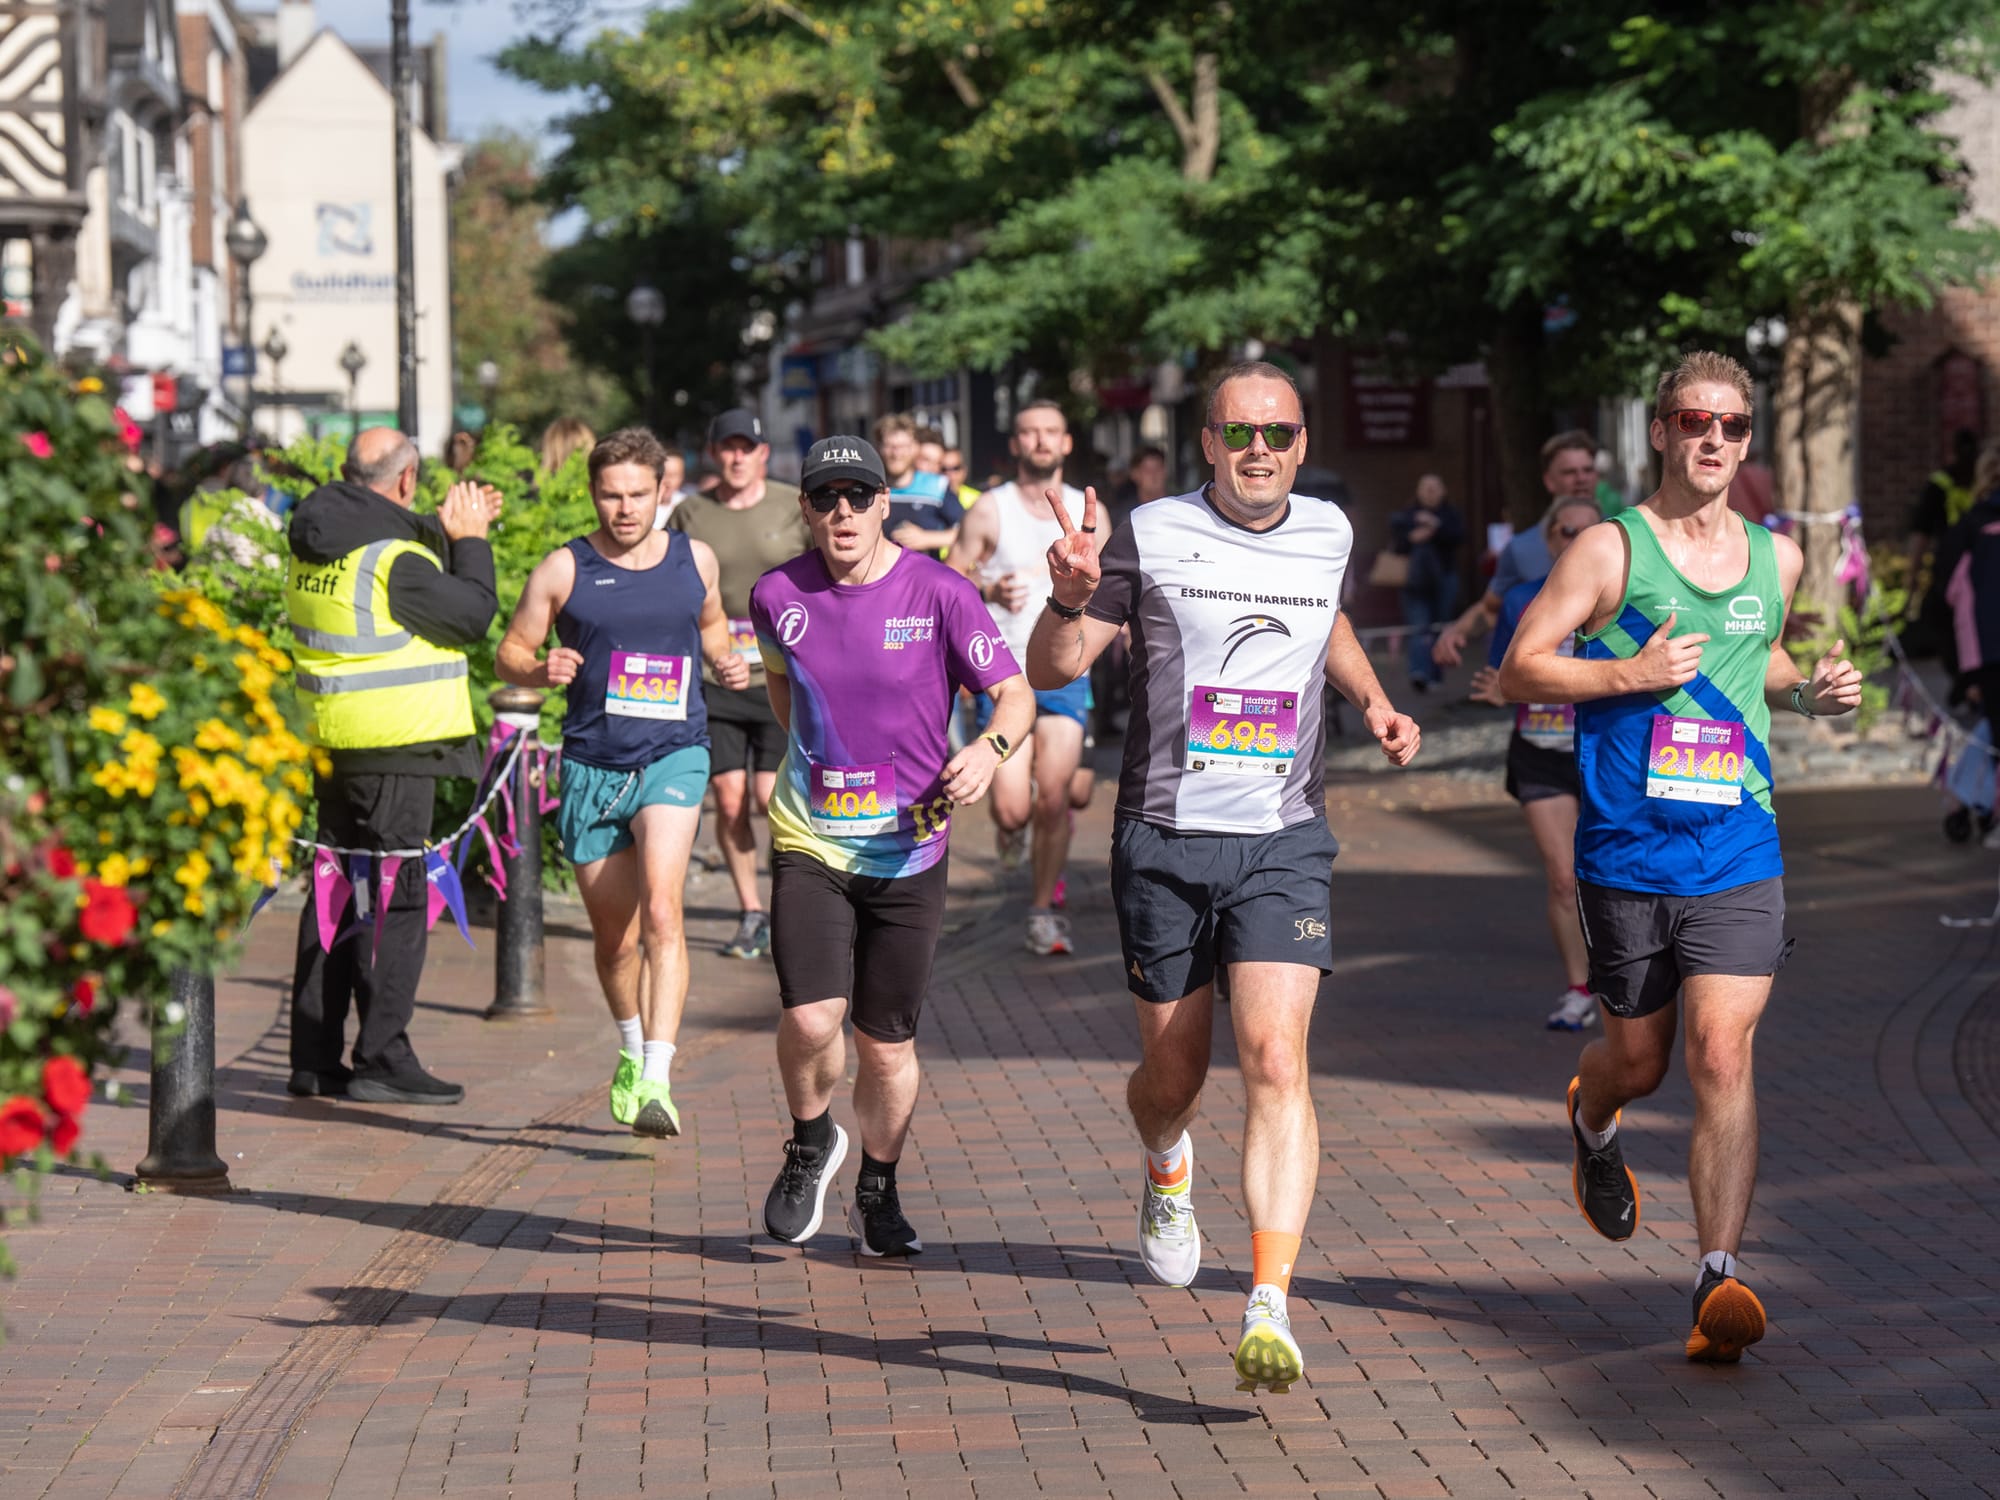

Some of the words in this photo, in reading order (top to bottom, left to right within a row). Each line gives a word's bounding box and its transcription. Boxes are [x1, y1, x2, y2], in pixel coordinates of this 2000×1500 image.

[823, 448, 859, 460] UTAH
[295, 573, 339, 595] staff
[1180, 587, 1251, 603] ESSINGTON
[1254, 594, 1314, 607] HARRIERS
[1316, 598, 1329, 608] RC
[884, 615, 934, 628] stafford
[1724, 620, 1767, 631] MH&AC
[884, 628, 913, 642] 10K
[617, 674, 678, 702] 1635
[1244, 695, 1277, 705] stafford
[1244, 704, 1262, 714] 10K
[1209, 719, 1278, 753] 695
[1701, 726, 1731, 736] stafford
[1701, 733, 1718, 744] 10K
[1657, 745, 1739, 782] 2140
[845, 770, 875, 779] stafford
[823, 790, 880, 817] 404
